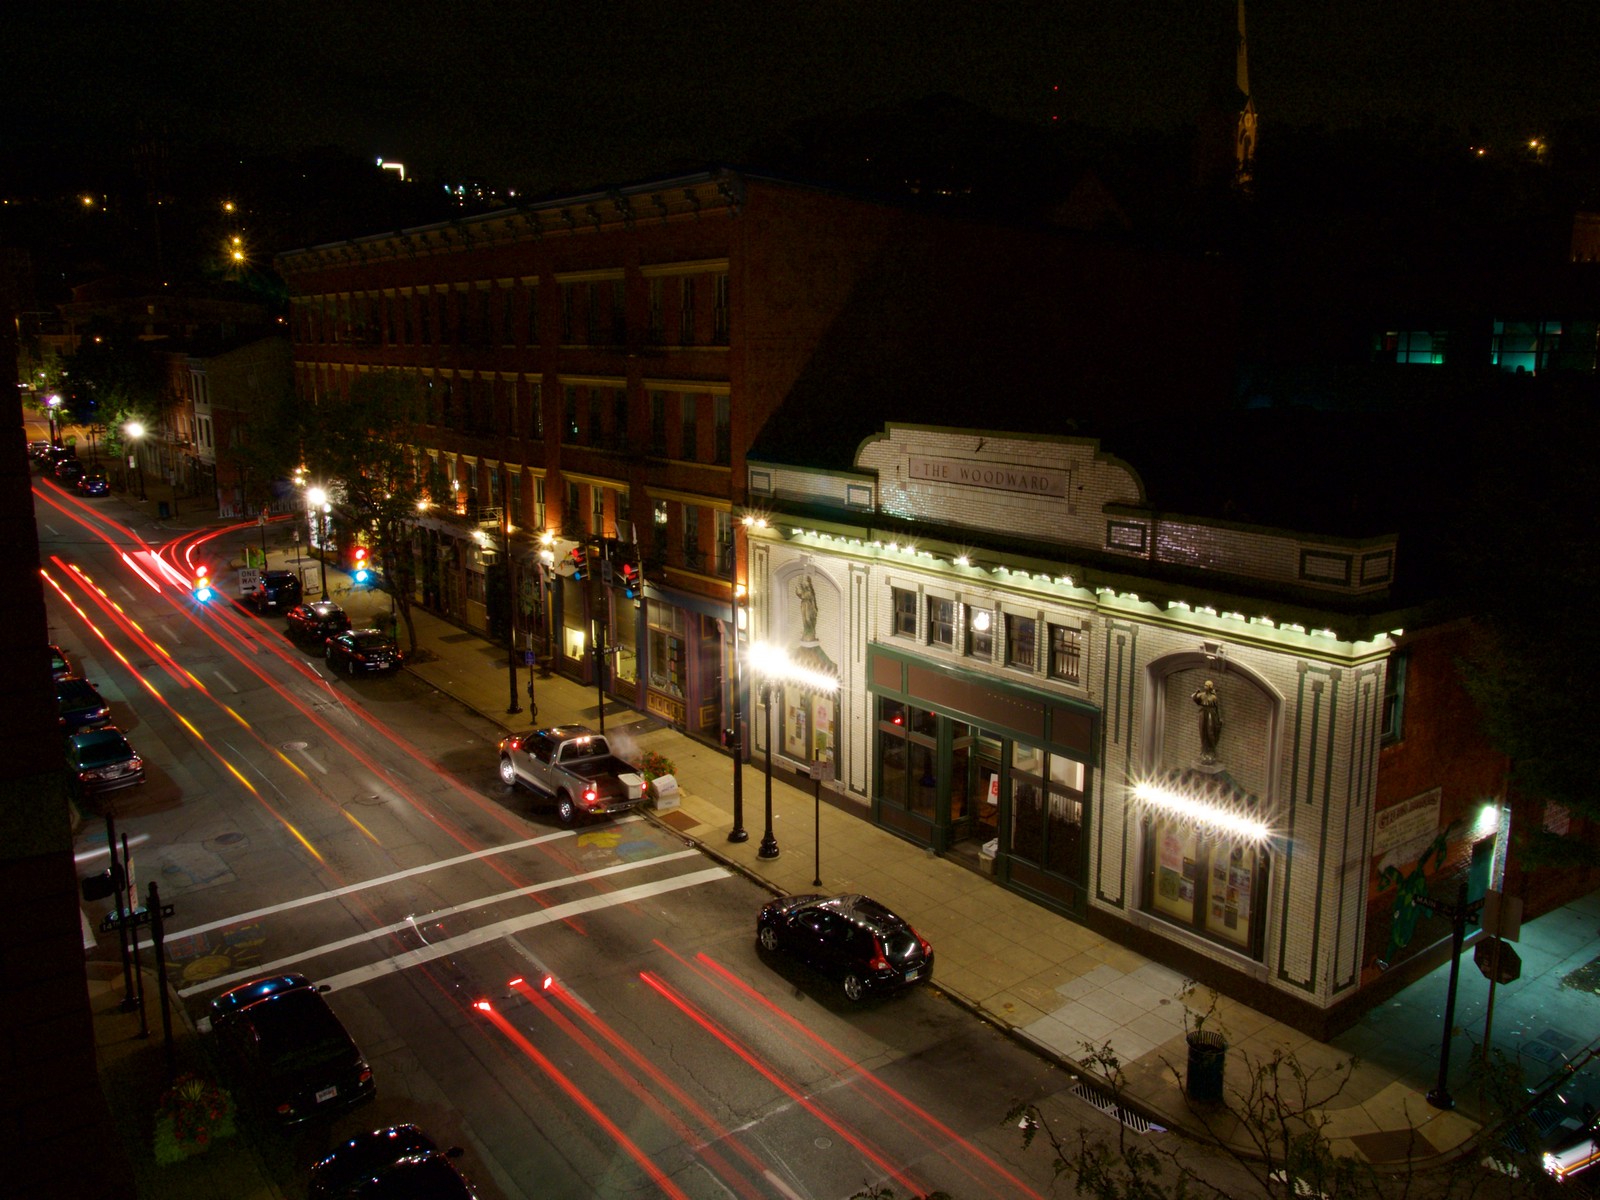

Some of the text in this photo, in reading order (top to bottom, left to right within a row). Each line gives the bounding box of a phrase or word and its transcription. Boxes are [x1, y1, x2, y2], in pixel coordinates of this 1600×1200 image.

[924, 463, 1049, 490] THE WOODWARD
[1416, 896, 1436, 909] MAIN
